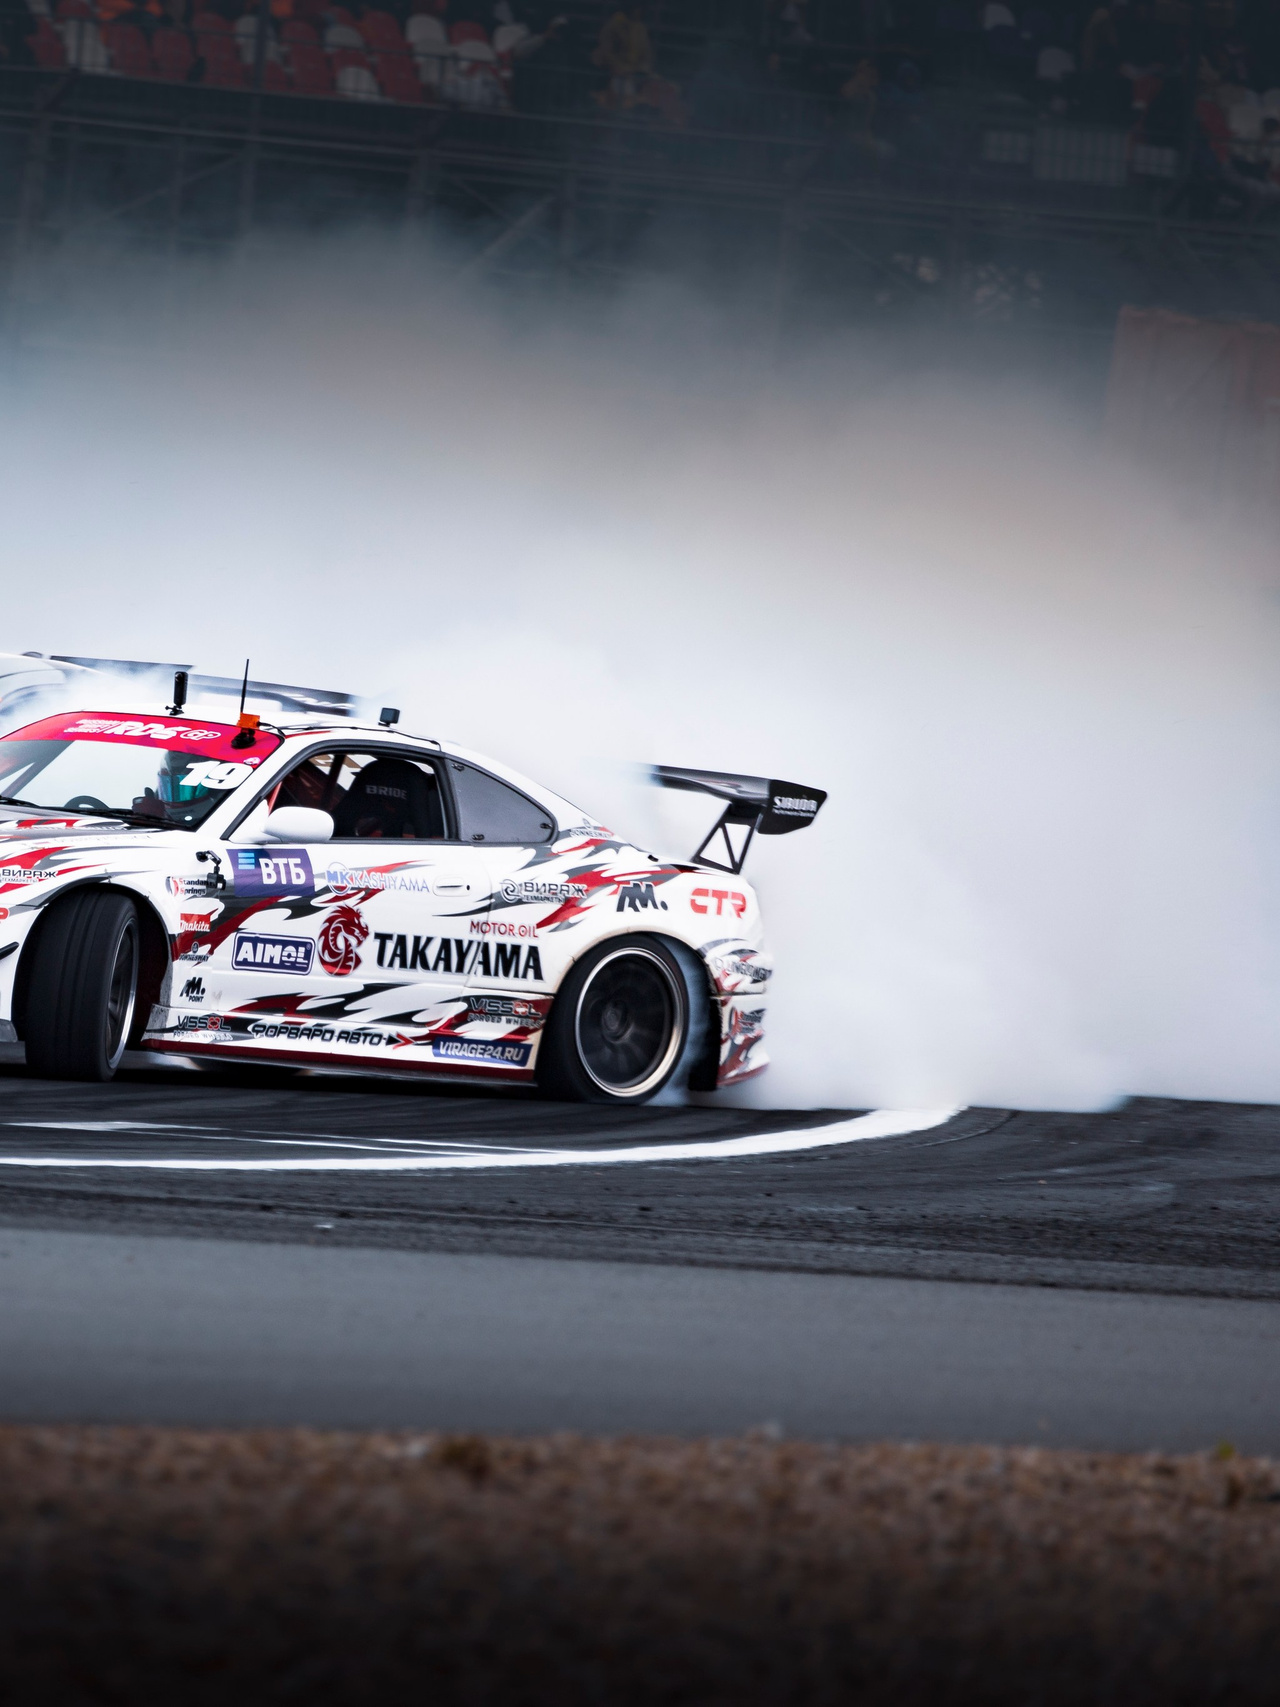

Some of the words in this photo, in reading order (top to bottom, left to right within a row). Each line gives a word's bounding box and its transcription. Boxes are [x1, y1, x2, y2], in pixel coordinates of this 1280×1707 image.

[103, 721, 192, 739] RDS
[180, 761, 254, 790] 19
[366, 784, 407, 800] BRIDE
[2, 868, 57, 878] ВИРАЖ
[259, 858, 306, 885] ВТБ
[351, 872, 429, 893] KASHIYAMA
[524, 881, 586, 898] ВИРАЖ
[690, 888, 746, 919] CTR
[470, 919, 514, 936] MOTOR
[518, 925, 539, 938] OIL
[236, 942, 308, 966] AIMOL
[374, 932, 544, 980] TAKAYAMA
[470, 997, 542, 1018] VISSOL
[178, 1015, 231, 1031] VISSOL
[467, 1013, 502, 1024] FORGED
[505, 1017, 543, 1029] WHEELS
[440, 1041, 524, 1061] VIRAGE24.RU
